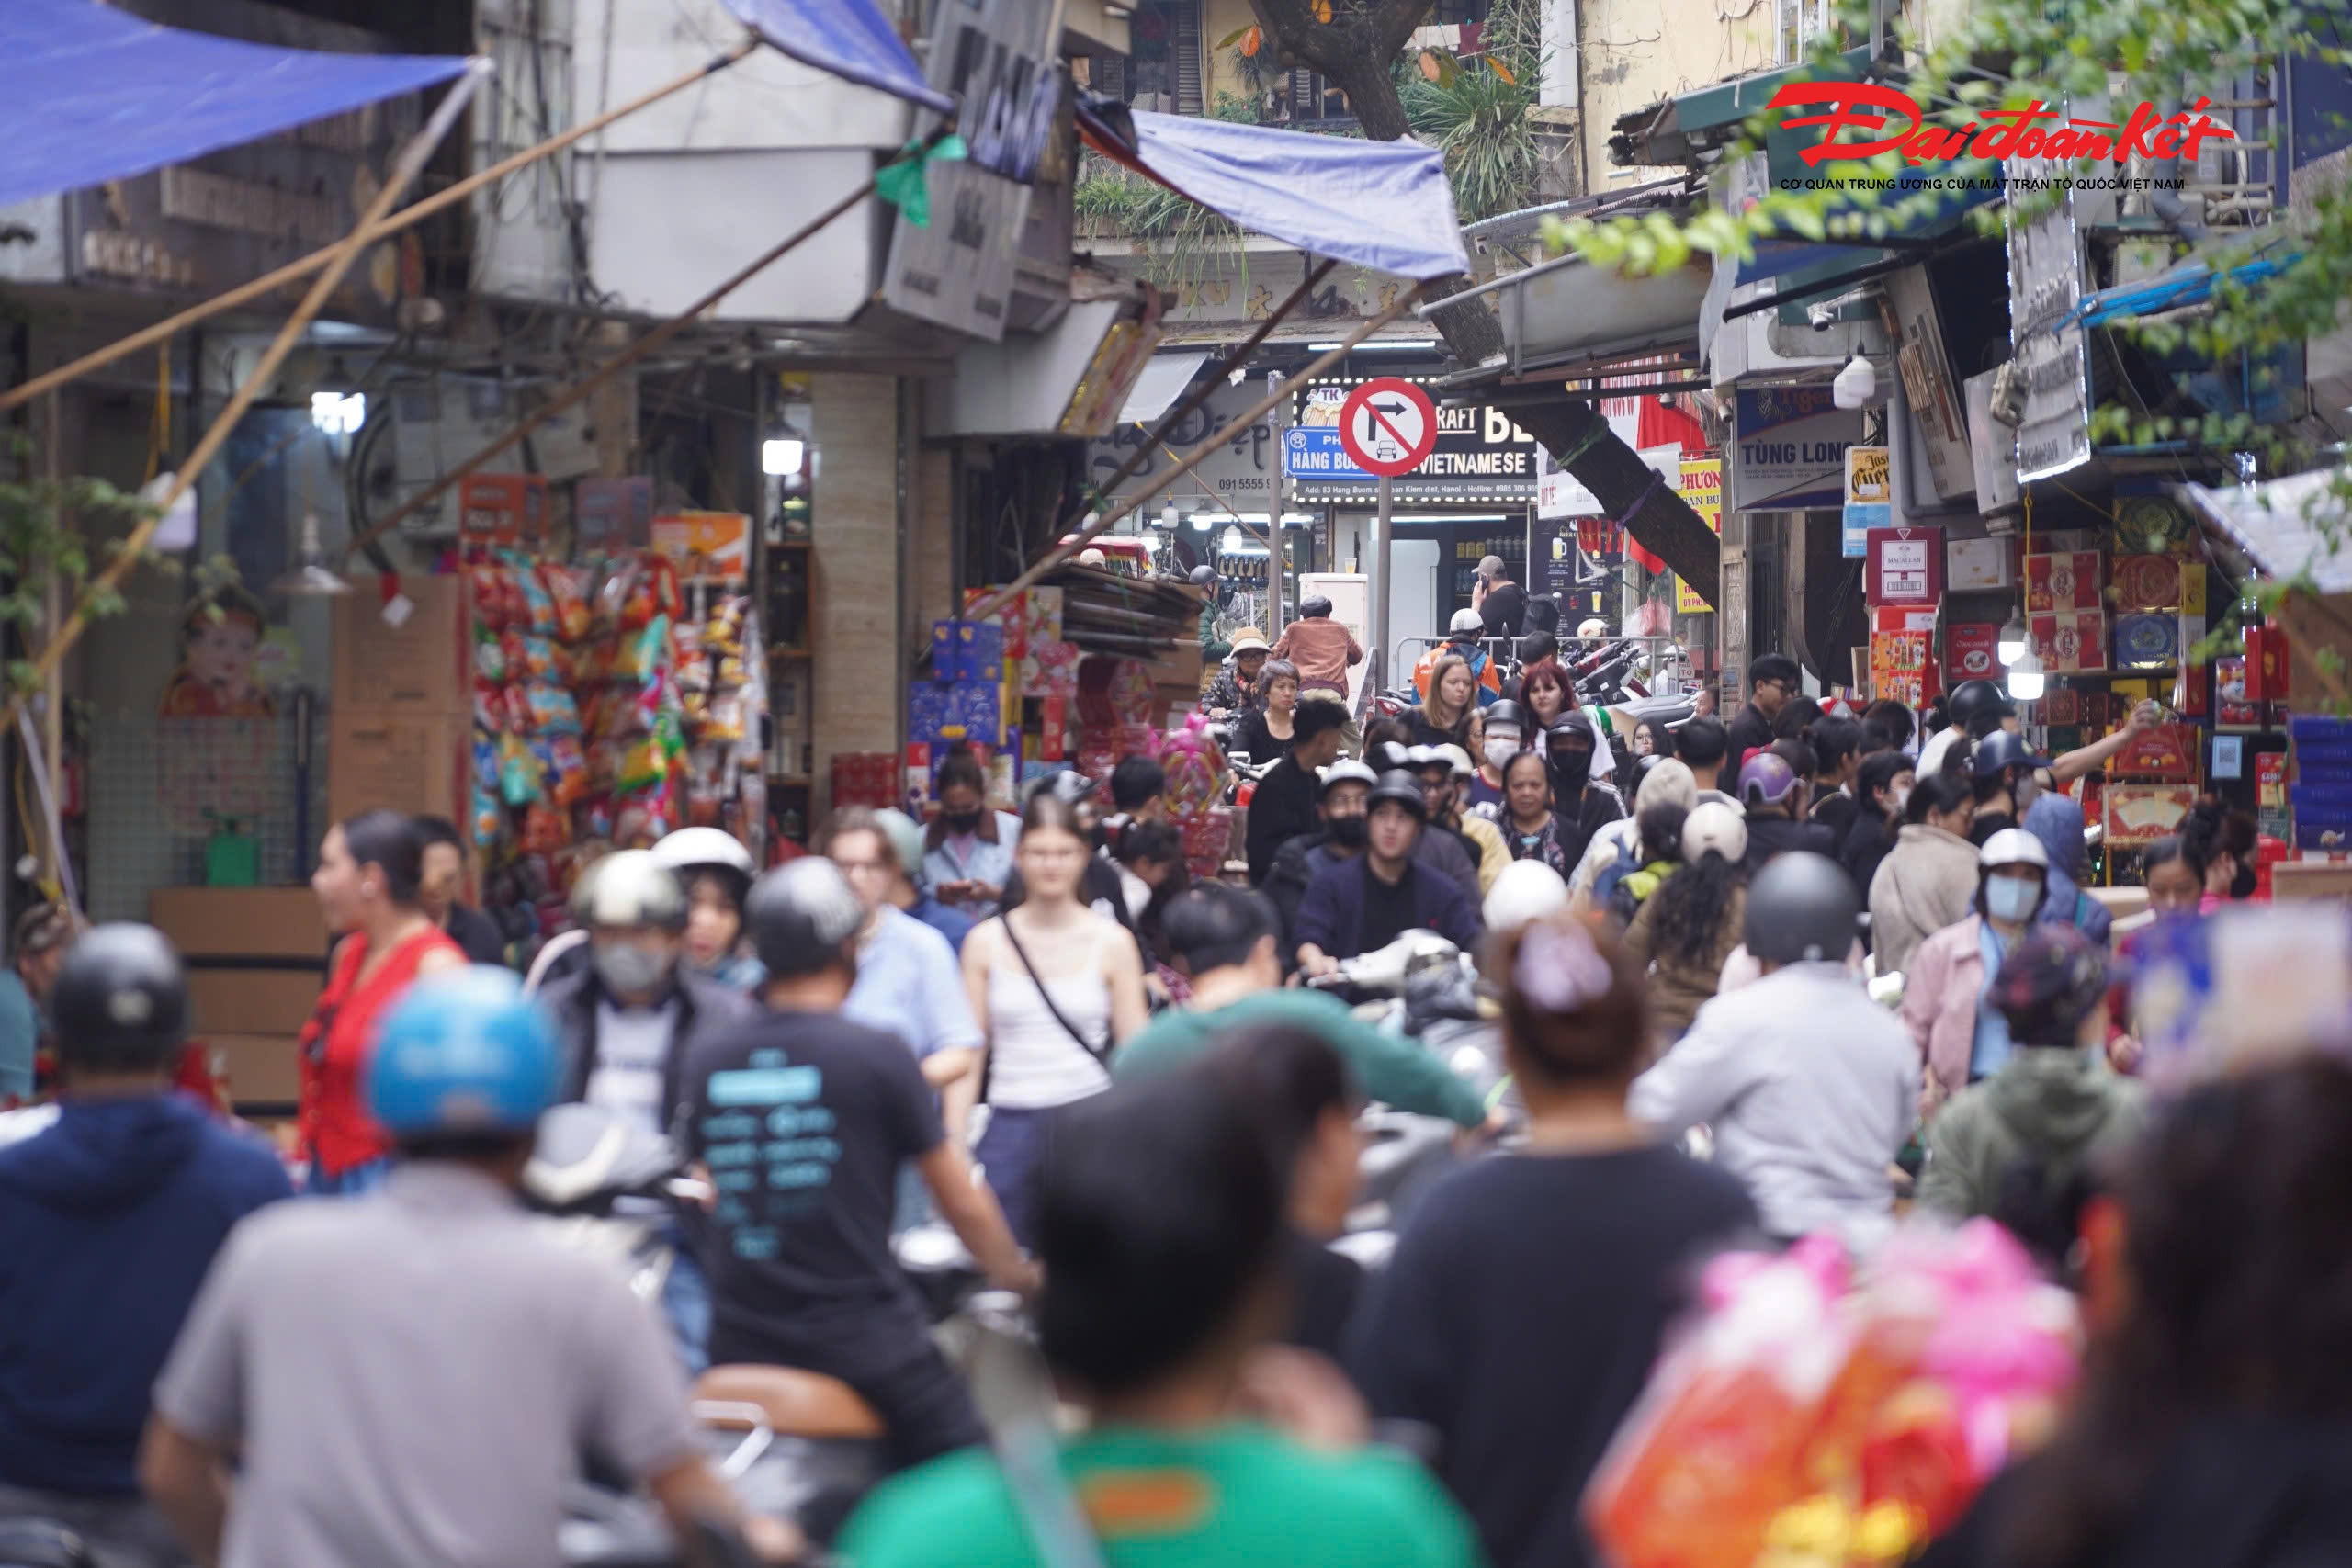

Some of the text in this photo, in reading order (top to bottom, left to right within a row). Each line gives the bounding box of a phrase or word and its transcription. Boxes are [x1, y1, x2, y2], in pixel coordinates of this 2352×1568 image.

[1321, 389, 1339, 401] TK
[1292, 448, 1330, 469] HÀNG
[1741, 439, 1854, 465] TÙNG LON
[1420, 452, 1526, 474] VIETNAMESE
[1218, 479, 1237, 490] 091
[1238, 478, 1264, 490] 5555
[1332, 486, 1351, 495] Hang
[1352, 486, 1373, 494] Buom
[1405, 485, 1423, 493] Kiem
[1441, 485, 1462, 493] Hanoi
[1467, 485, 1494, 493] Hotline:
